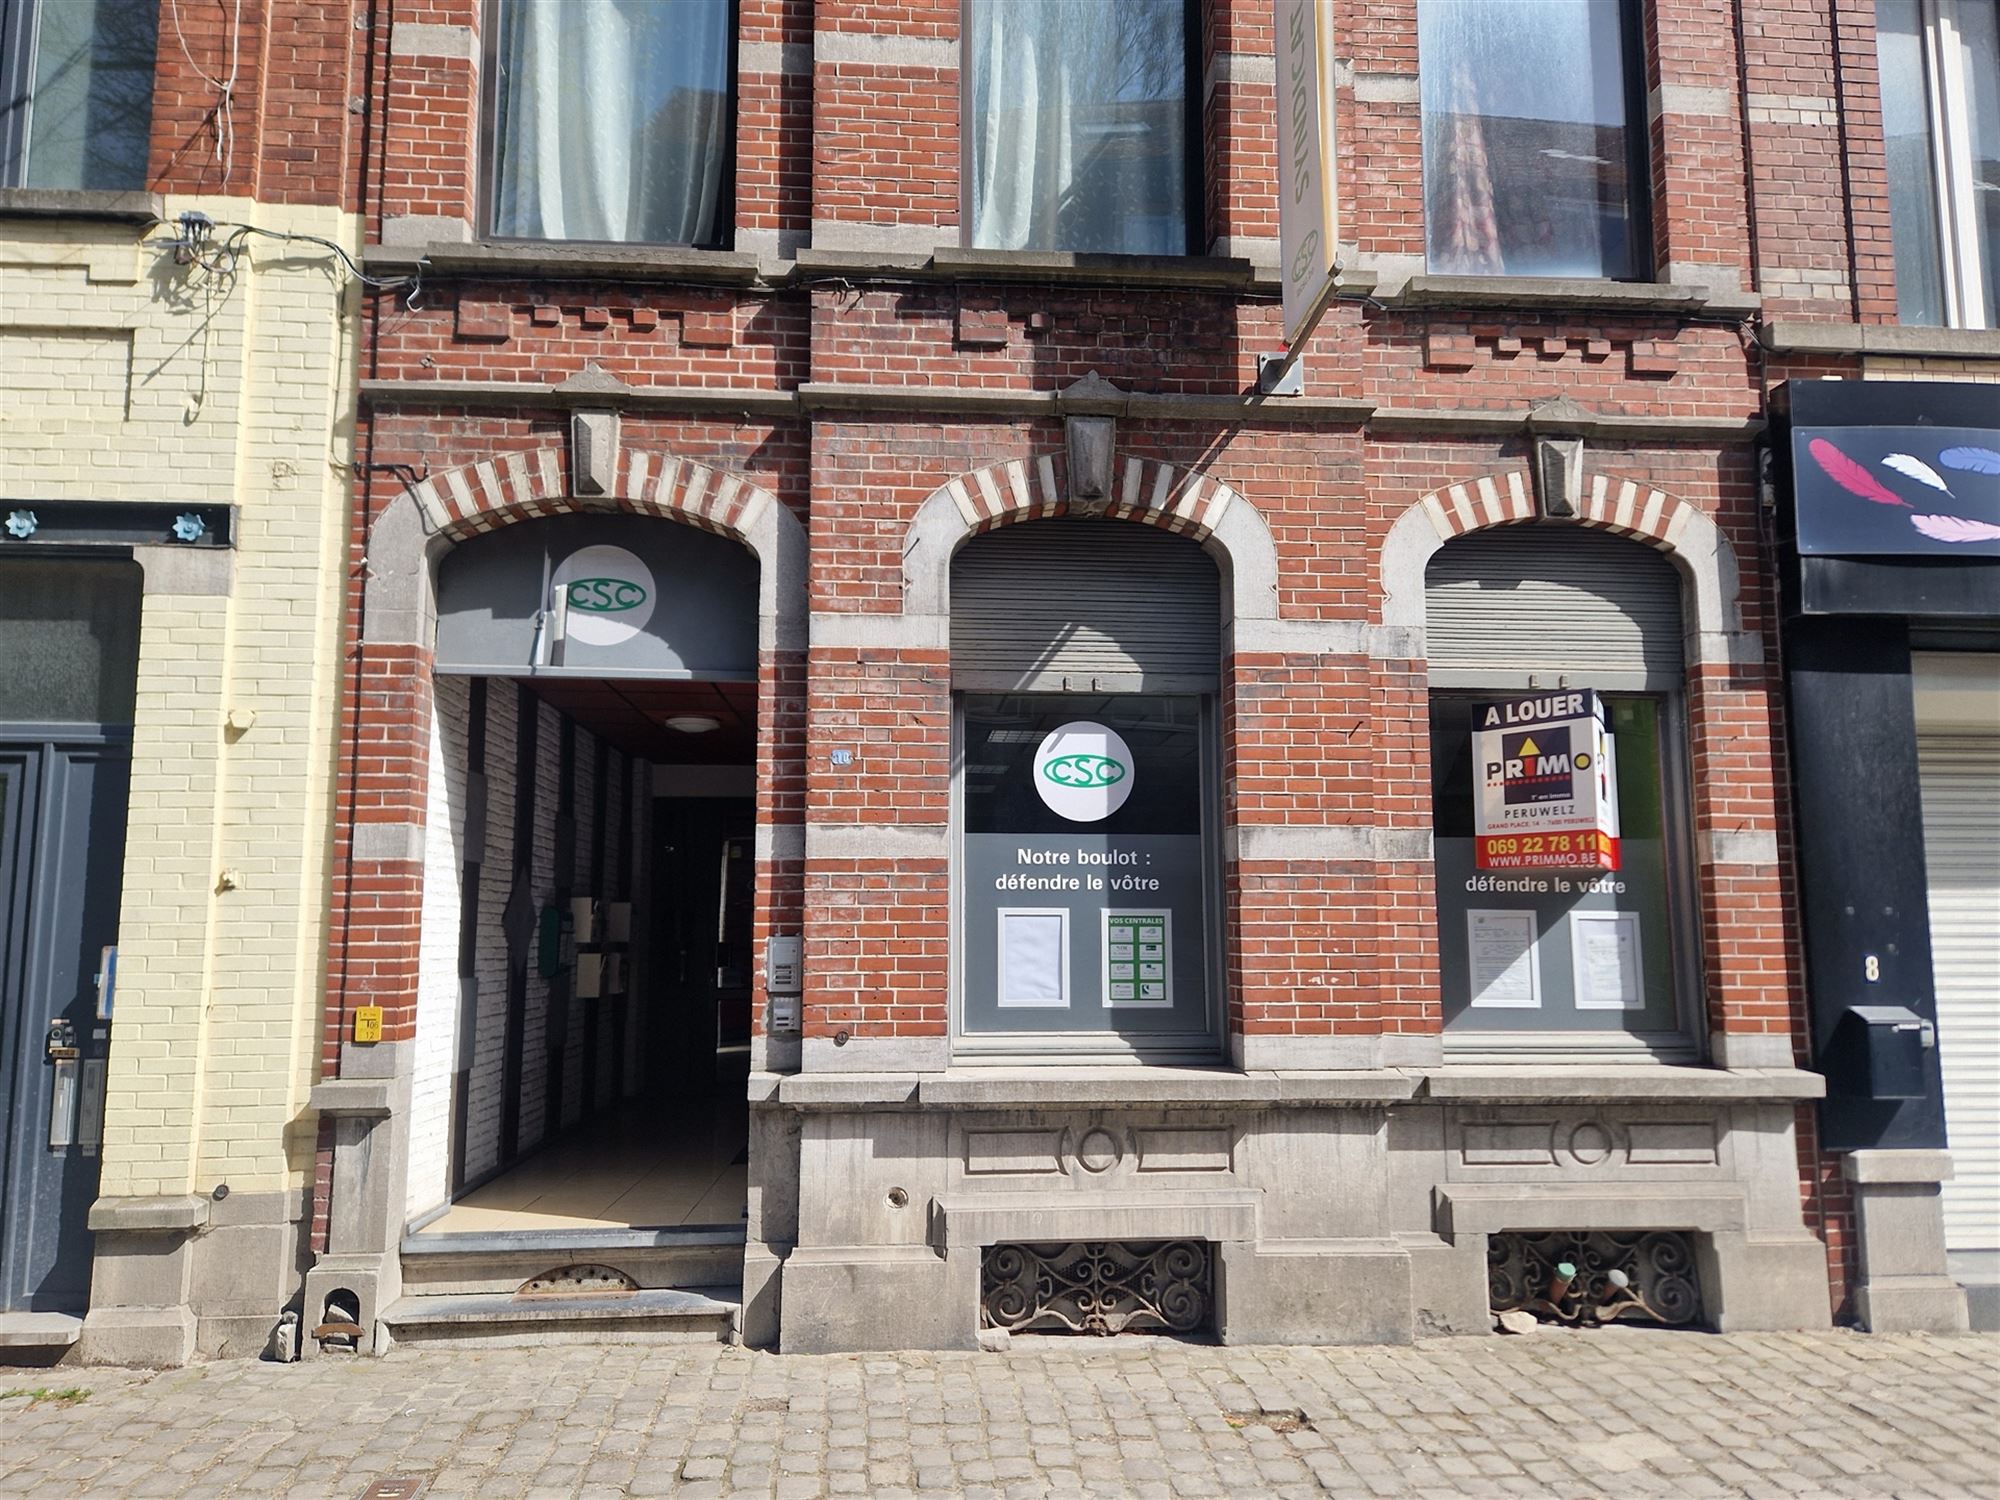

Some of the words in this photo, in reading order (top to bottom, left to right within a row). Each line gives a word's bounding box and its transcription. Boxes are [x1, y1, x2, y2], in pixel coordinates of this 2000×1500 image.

[1293, 233, 1315, 280] CSC
[570, 580, 636, 609] CSC
[1485, 706, 1500, 726] A
[1506, 694, 1585, 723] LOUER
[1052, 757, 1116, 786] CSC
[1487, 750, 1592, 780] PRIMMO
[1504, 805, 1575, 819] PERUWELZ
[1487, 838, 1518, 855] 069
[1522, 837, 1544, 853] 22
[1548, 835, 1571, 851] 78
[1576, 833, 1597, 850] 11
[1017, 848, 1070, 865] Notre
[1077, 848, 1138, 865] boulot
[1488, 852, 1597, 867] WWW.PRIMMO.BE
[995, 874, 1080, 890] défendre
[1087, 874, 1103, 890] le
[1110, 874, 1160, 891] vôtre
[1465, 876, 1548, 893] défendre
[1554, 877, 1571, 893] le
[1576, 877, 1626, 893] vôtre
[1109, 917, 1124, 925] VOS
[1125, 917, 1164, 925] CENTRALES
[1865, 955, 1880, 981] 8
